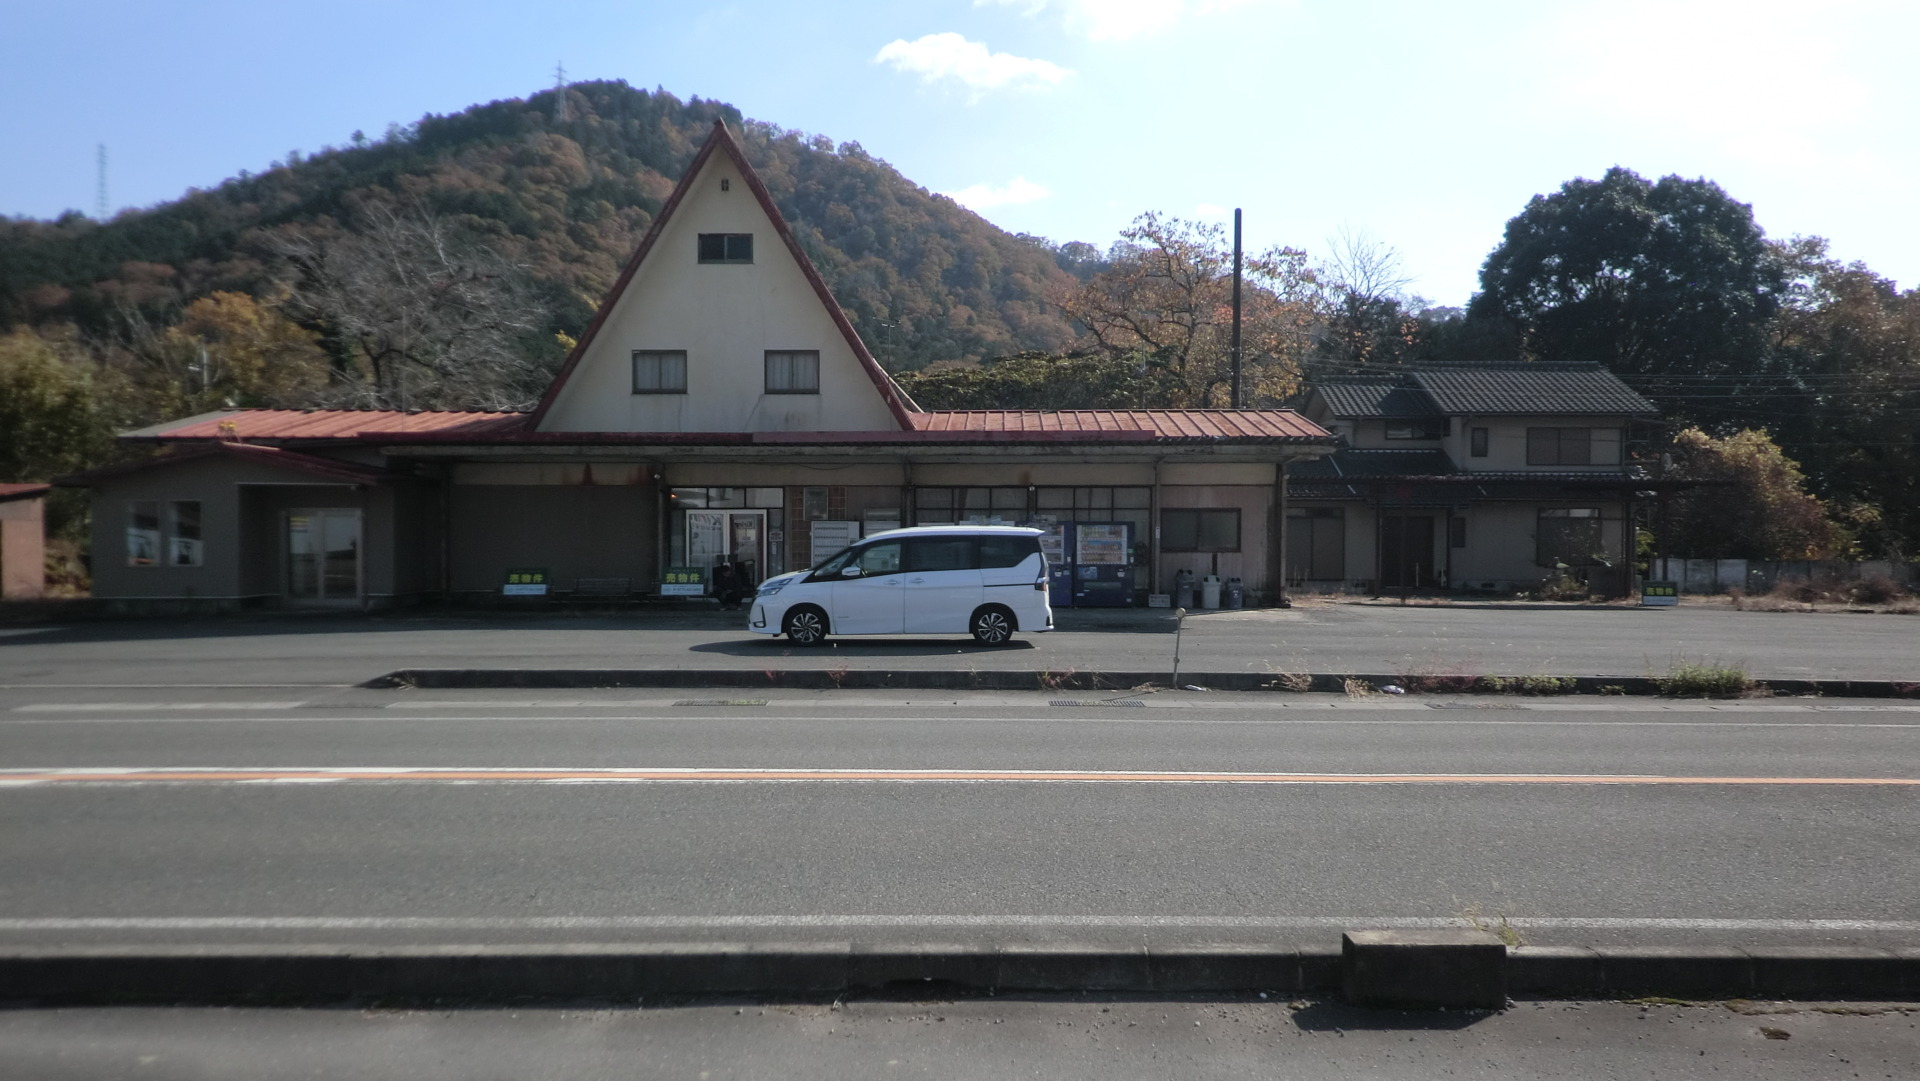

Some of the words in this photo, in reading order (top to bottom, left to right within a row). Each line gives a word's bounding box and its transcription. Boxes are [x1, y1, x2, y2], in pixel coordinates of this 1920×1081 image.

[509, 573, 543, 583] 売物件
[665, 572, 700, 583] 売物件
